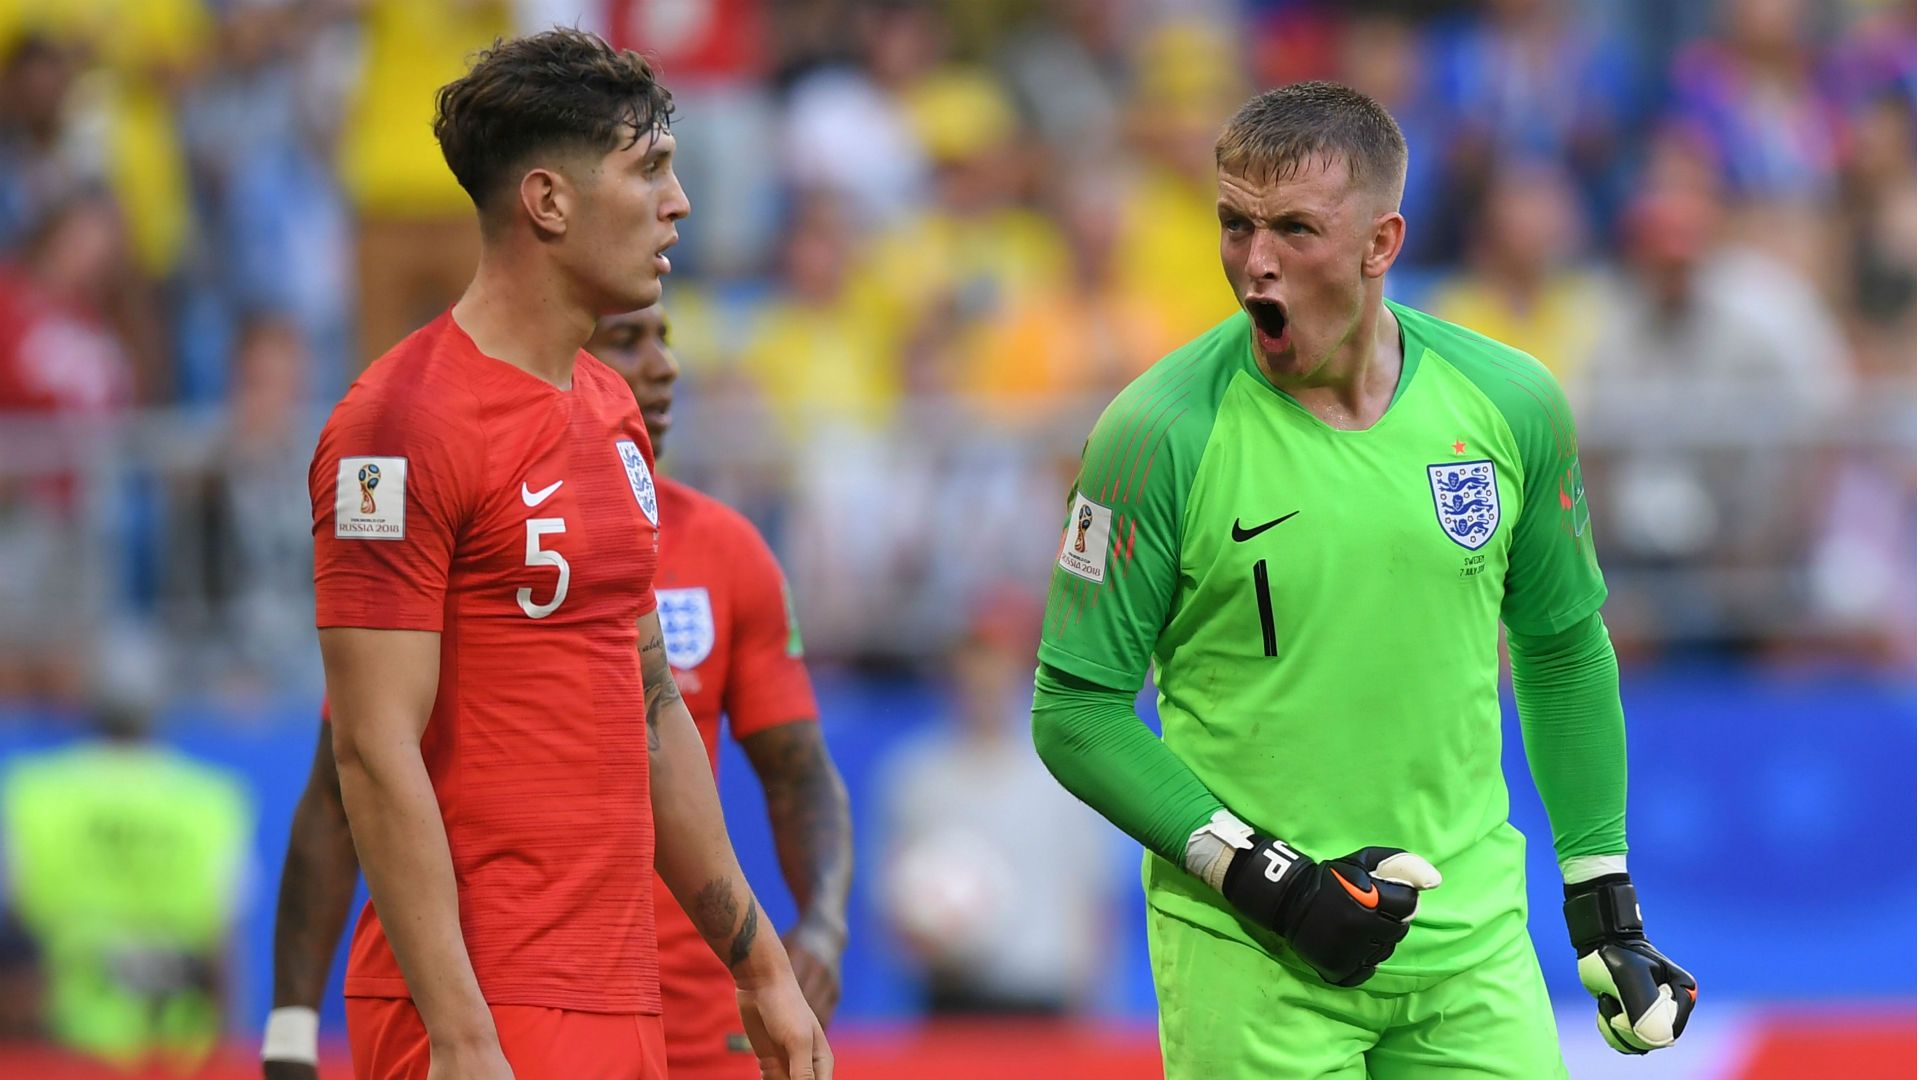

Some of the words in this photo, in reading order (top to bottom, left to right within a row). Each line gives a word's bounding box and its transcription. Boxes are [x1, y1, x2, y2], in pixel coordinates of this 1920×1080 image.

[340, 523, 374, 532] RUSSIA
[375, 524, 399, 533] 2018
[516, 517, 570, 619] 5
[1081, 563, 1101, 577] 2018
[1253, 558, 1278, 657] 1
[1262, 839, 1300, 883] JP
